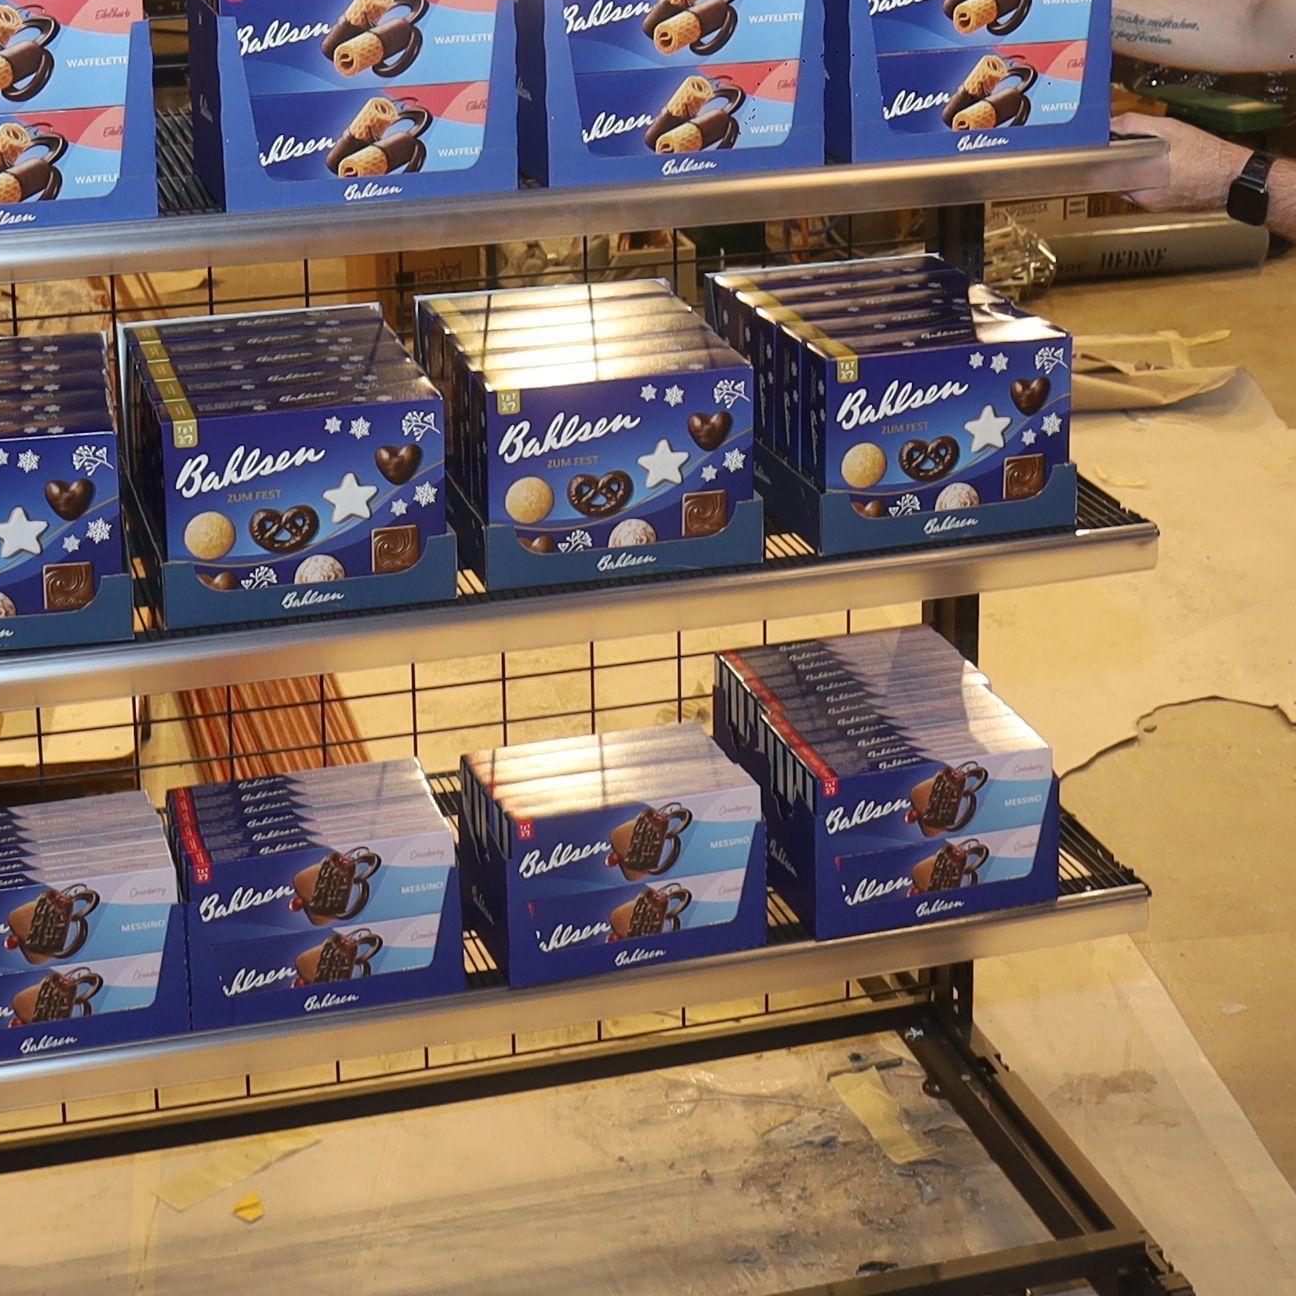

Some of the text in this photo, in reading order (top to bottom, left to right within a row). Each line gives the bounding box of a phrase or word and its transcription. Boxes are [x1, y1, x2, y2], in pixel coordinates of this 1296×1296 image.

[957, 134, 1009, 152] Bahlsen
[662, 158, 718, 176] Bahlsen
[344, 182, 402, 201] Bahlsen
[836, 379, 969, 431] Bahlsen
[498, 412, 641, 464] Bahlsen
[176, 445, 326, 498] Bahlsen
[923, 516, 979, 535] Bahlsen
[597, 552, 657, 572] Bahlsen
[281, 589, 345, 609] Bahlsen
[1004, 795, 1042, 806] MESSINO
[825, 796, 911, 834] Bahlsen
[710, 836, 749, 848] MESSINO
[519, 839, 611, 878] Bahlsen
[401, 881, 444, 893] MESSINO
[200, 883, 295, 922] Bahlsen
[916, 899, 965, 918] Bahlsen
[121, 919, 165, 932] MESSINO
[615, 947, 666, 967] Bahlsen
[304, 992, 359, 1011] Bahlsen
[20, 1034, 77, 1054] Bahlsen
